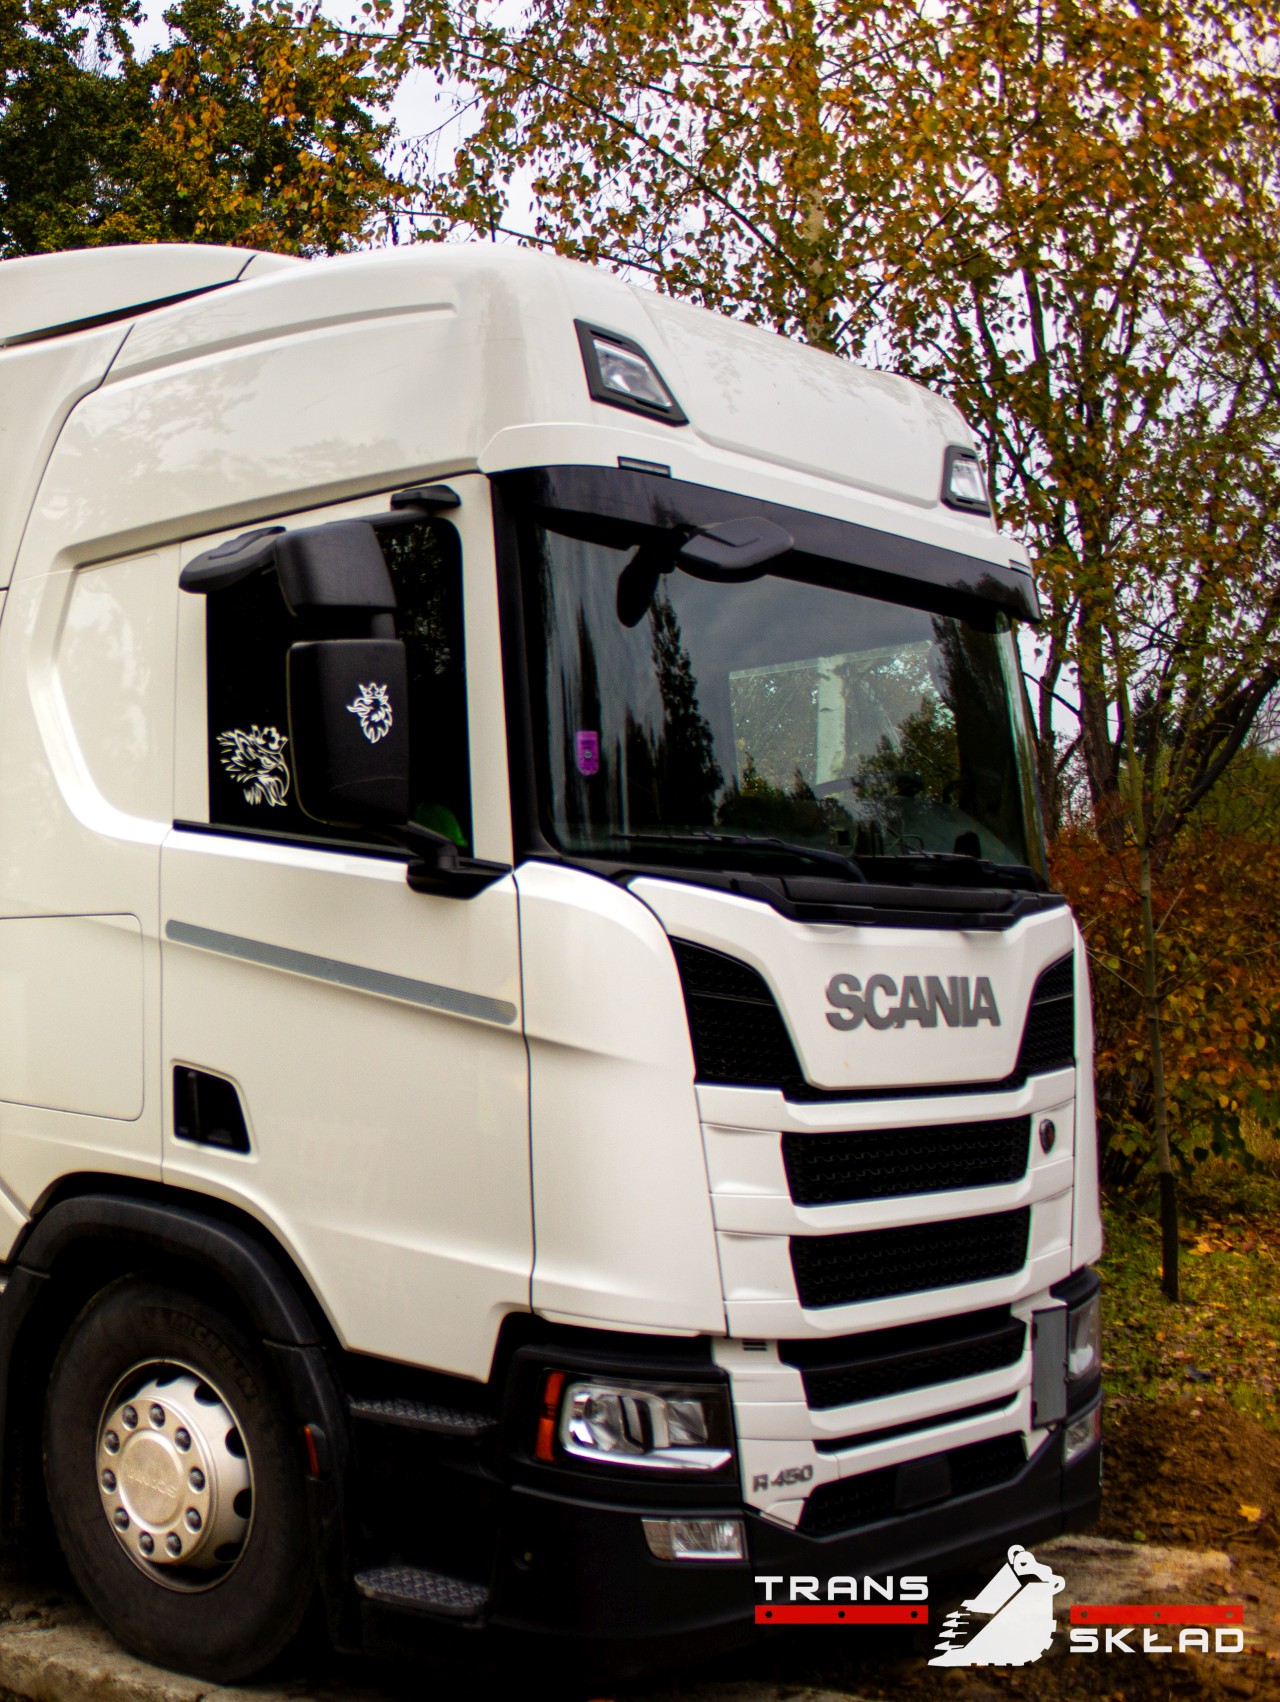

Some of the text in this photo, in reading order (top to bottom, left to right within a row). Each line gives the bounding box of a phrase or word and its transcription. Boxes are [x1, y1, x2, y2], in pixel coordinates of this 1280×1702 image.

[825, 973, 1001, 1032] SCANIA
[752, 1464, 813, 1492] R 450
